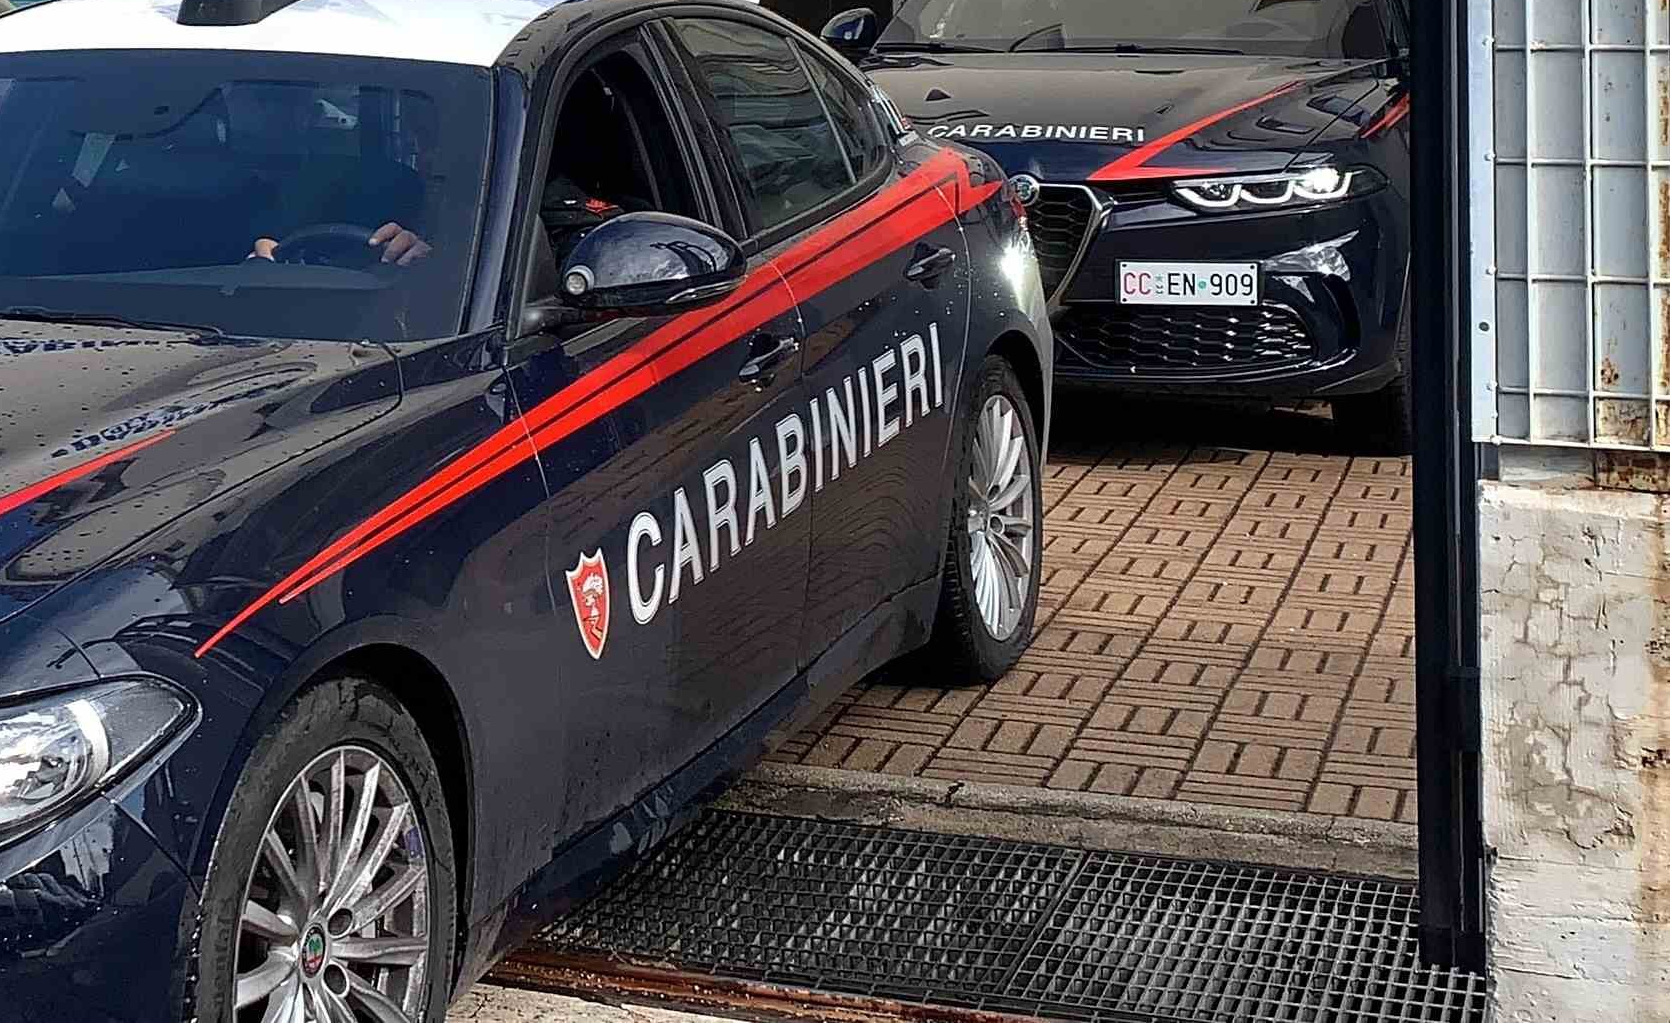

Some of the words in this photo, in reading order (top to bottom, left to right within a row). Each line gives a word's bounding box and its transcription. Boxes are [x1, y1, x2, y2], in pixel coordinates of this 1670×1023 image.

[926, 124, 1145, 143] CARABINIERI
[1123, 272, 1152, 295] CC
[1167, 272, 1196, 296] EN
[1210, 273, 1254, 296] 909
[626, 322, 947, 625] CARABINIERI
